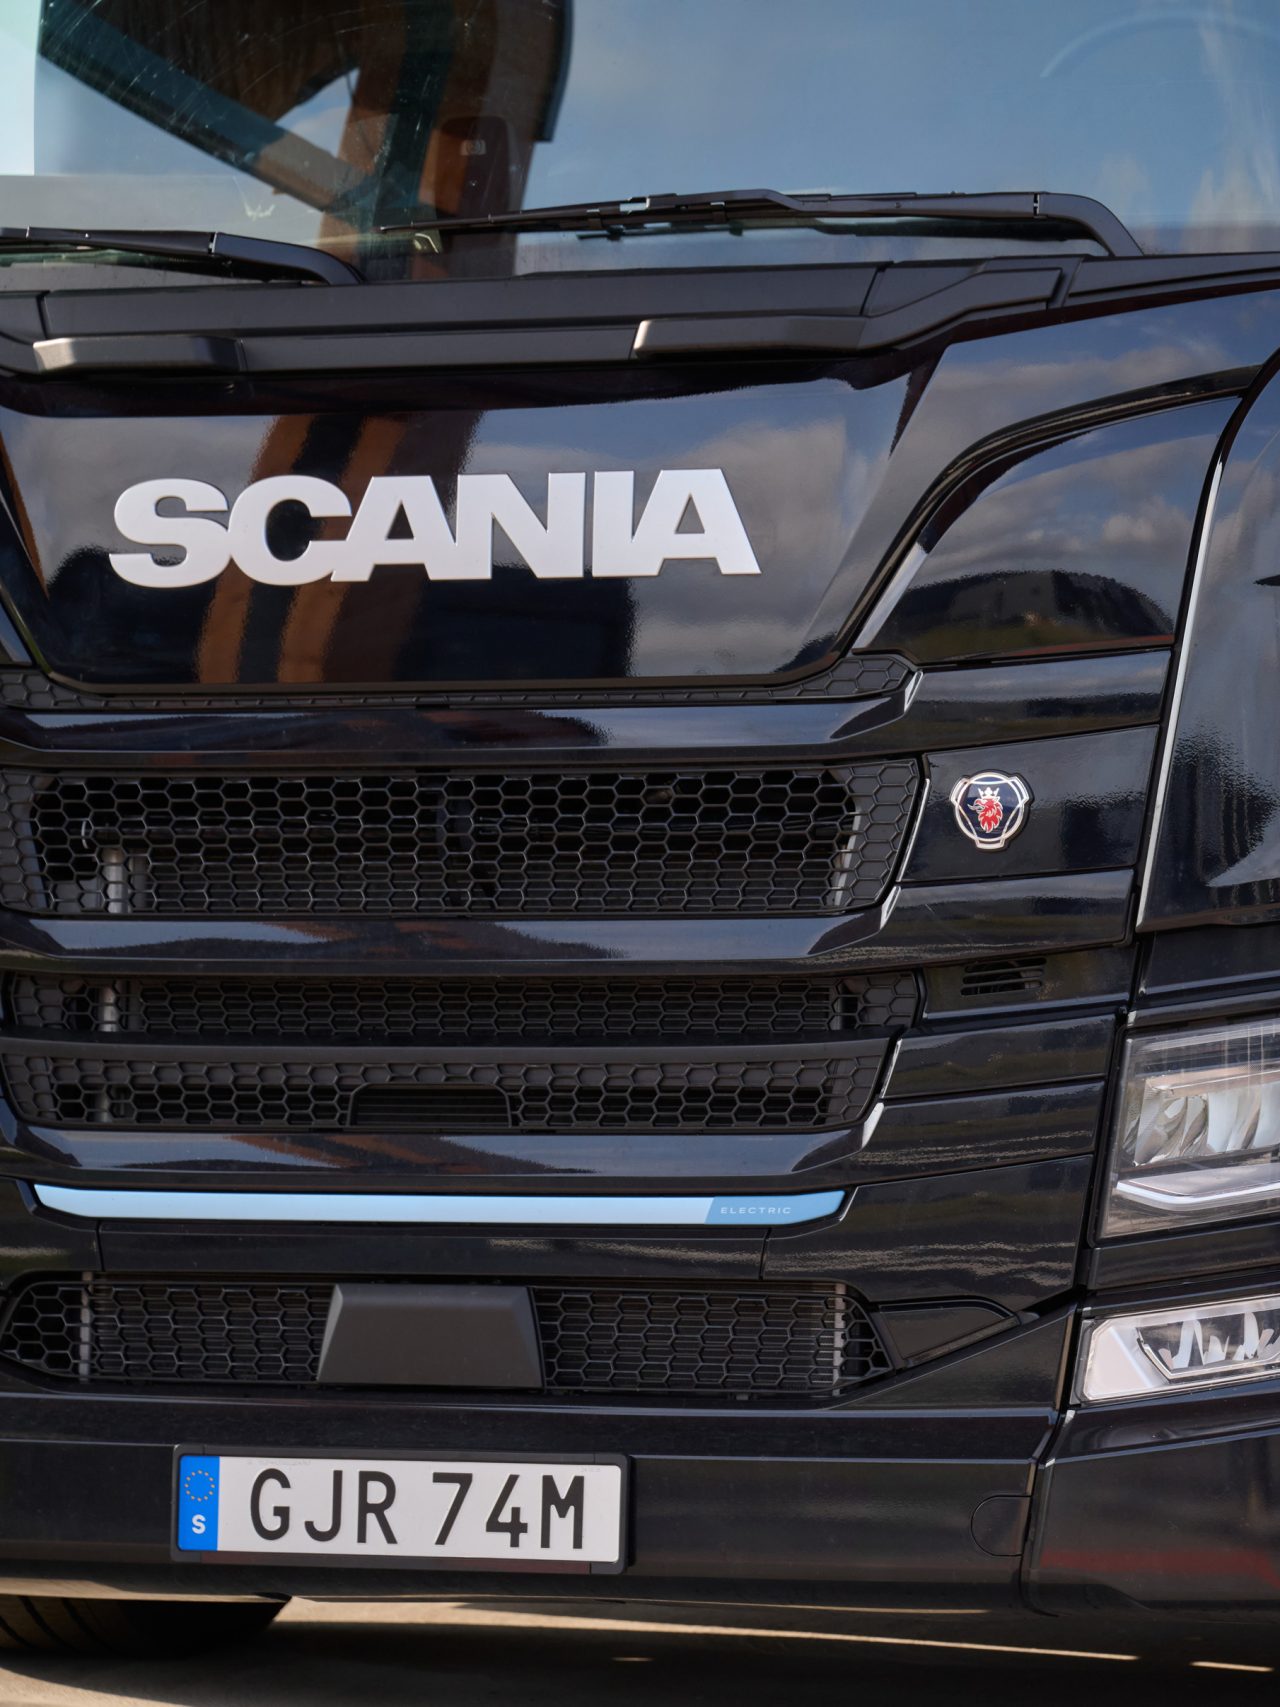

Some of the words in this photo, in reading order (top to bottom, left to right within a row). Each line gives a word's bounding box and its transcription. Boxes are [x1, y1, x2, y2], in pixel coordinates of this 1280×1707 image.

[109, 468, 761, 588] SCANIA
[720, 1206, 793, 1215] ELECTRIC
[191, 1514, 206, 1534] S
[250, 1468, 398, 1545] GJR
[432, 1472, 585, 1550] 74M
